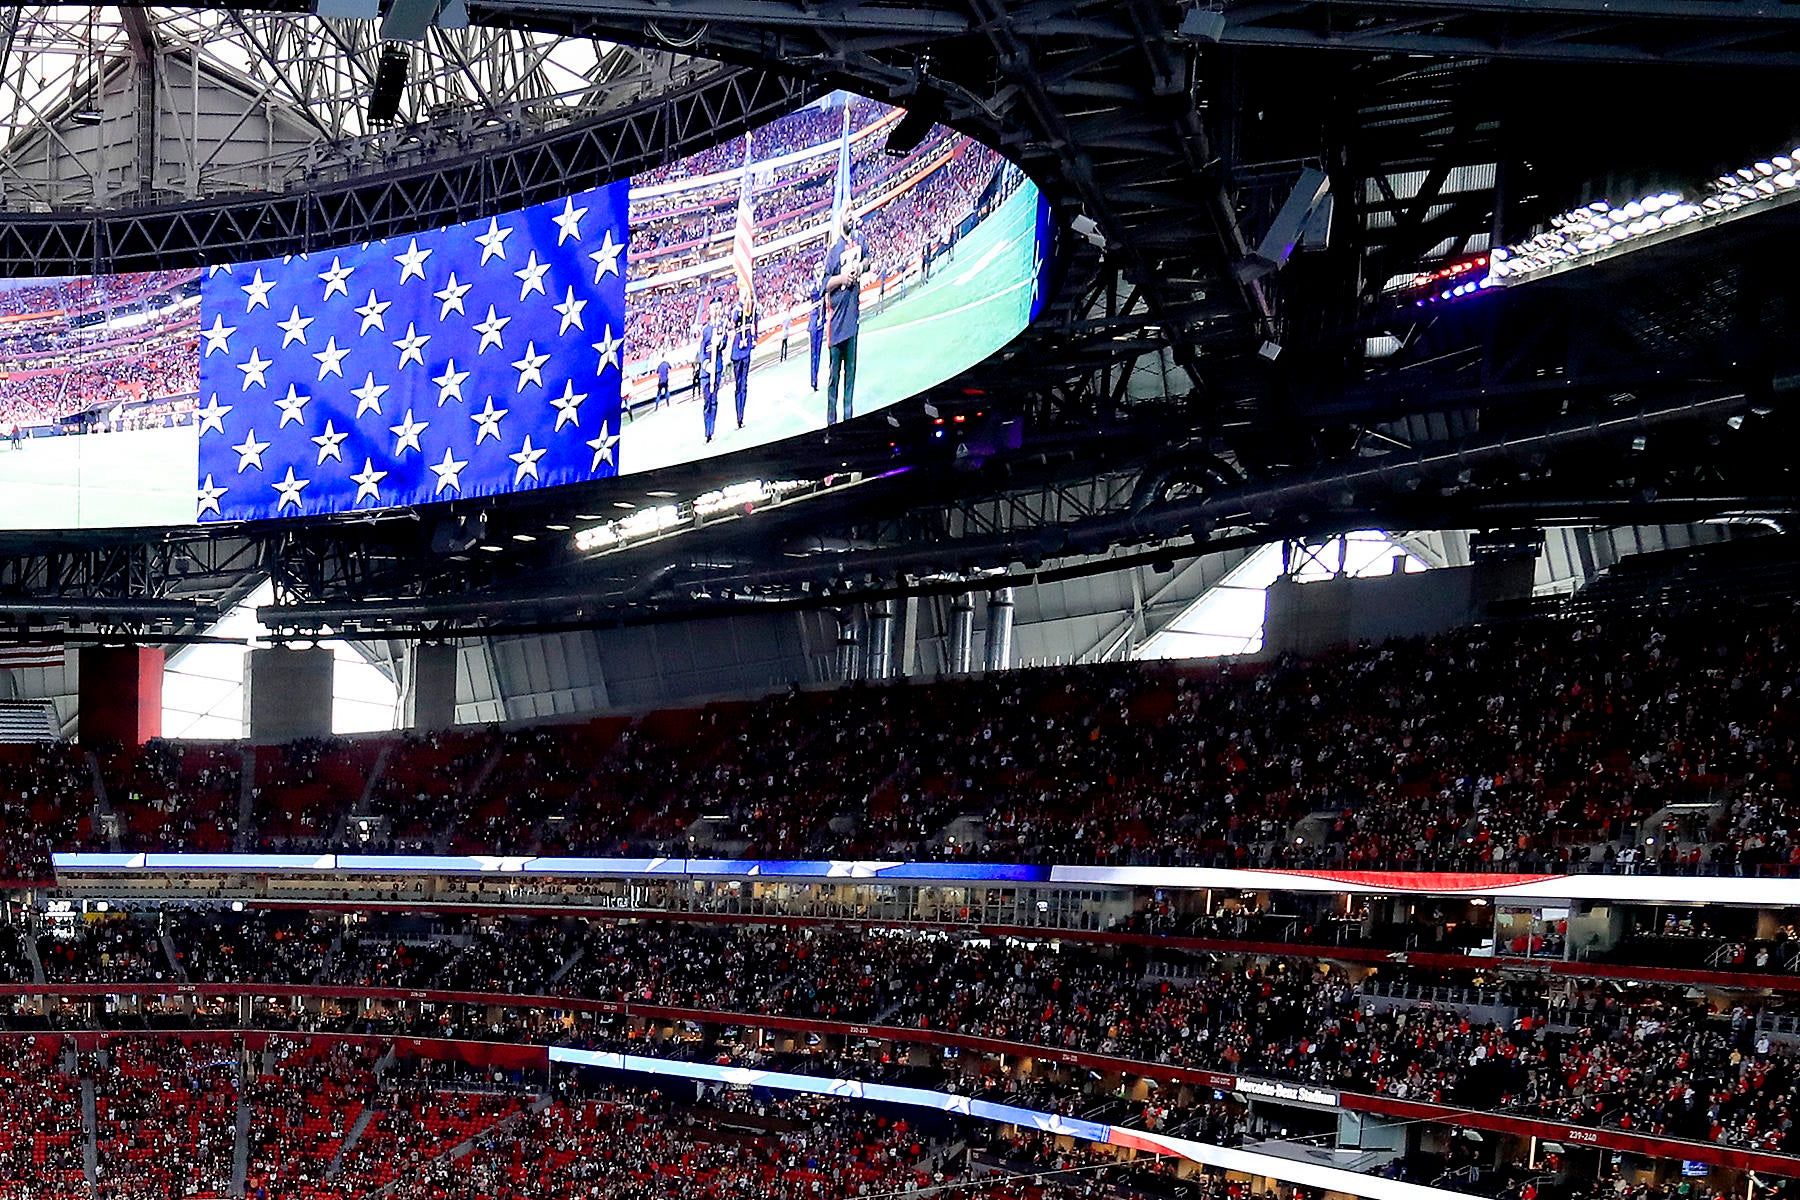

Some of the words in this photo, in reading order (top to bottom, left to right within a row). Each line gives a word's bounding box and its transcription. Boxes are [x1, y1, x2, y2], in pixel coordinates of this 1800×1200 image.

[1235, 1078, 1298, 1100] Mercedes-Benz
[1298, 1087, 1336, 1106] Stadium
[1569, 1130, 1597, 1142] 239-240
